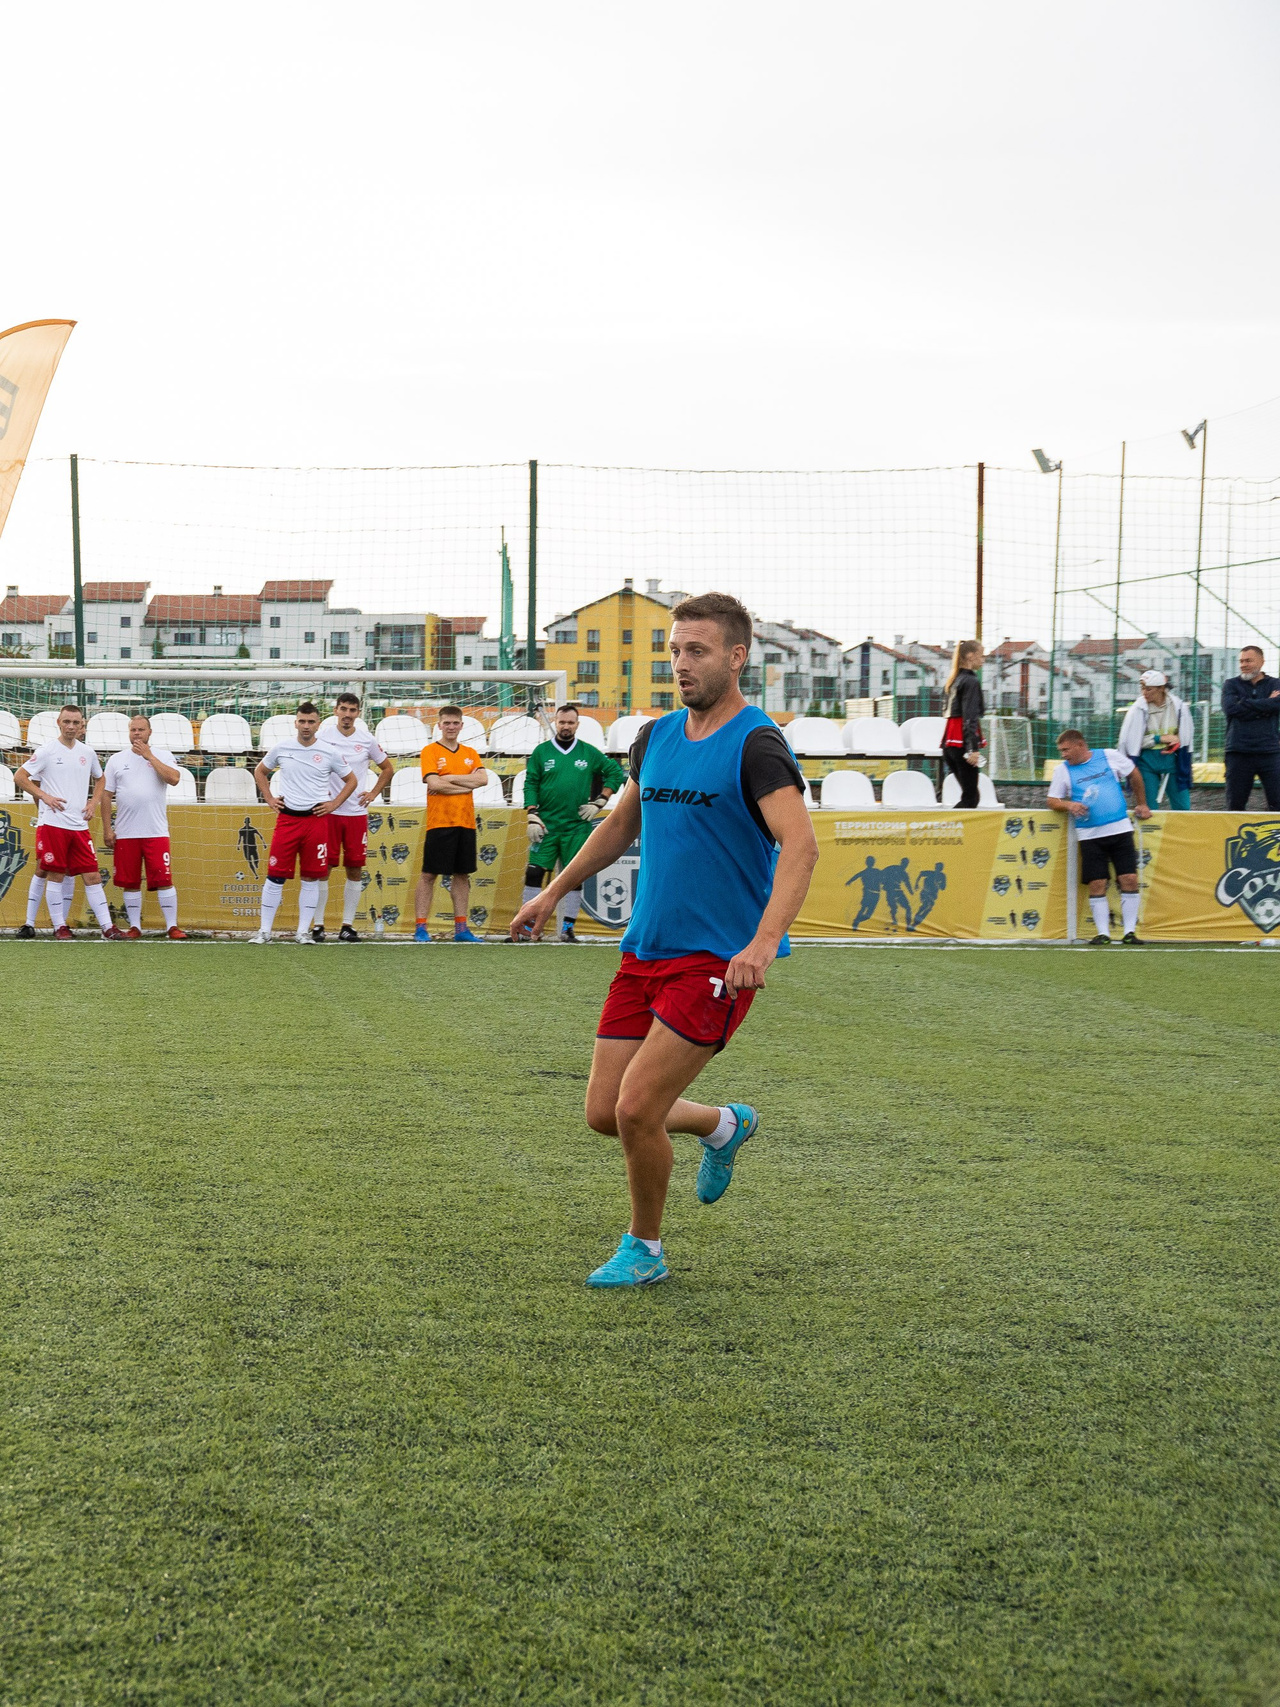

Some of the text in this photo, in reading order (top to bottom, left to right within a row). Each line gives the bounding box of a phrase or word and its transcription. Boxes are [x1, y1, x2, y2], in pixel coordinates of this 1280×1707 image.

[641, 787, 720, 808] DEMIX
[834, 821, 964, 830] ТЕРРИТОРИЯ ФУТБОЛА
[163, 852, 171, 867] 9
[223, 884, 264, 892] FOOTB
[1216, 867, 1280, 906] Соч
[220, 896, 283, 905] TERRIT
[232, 908, 262, 917] SIRI
